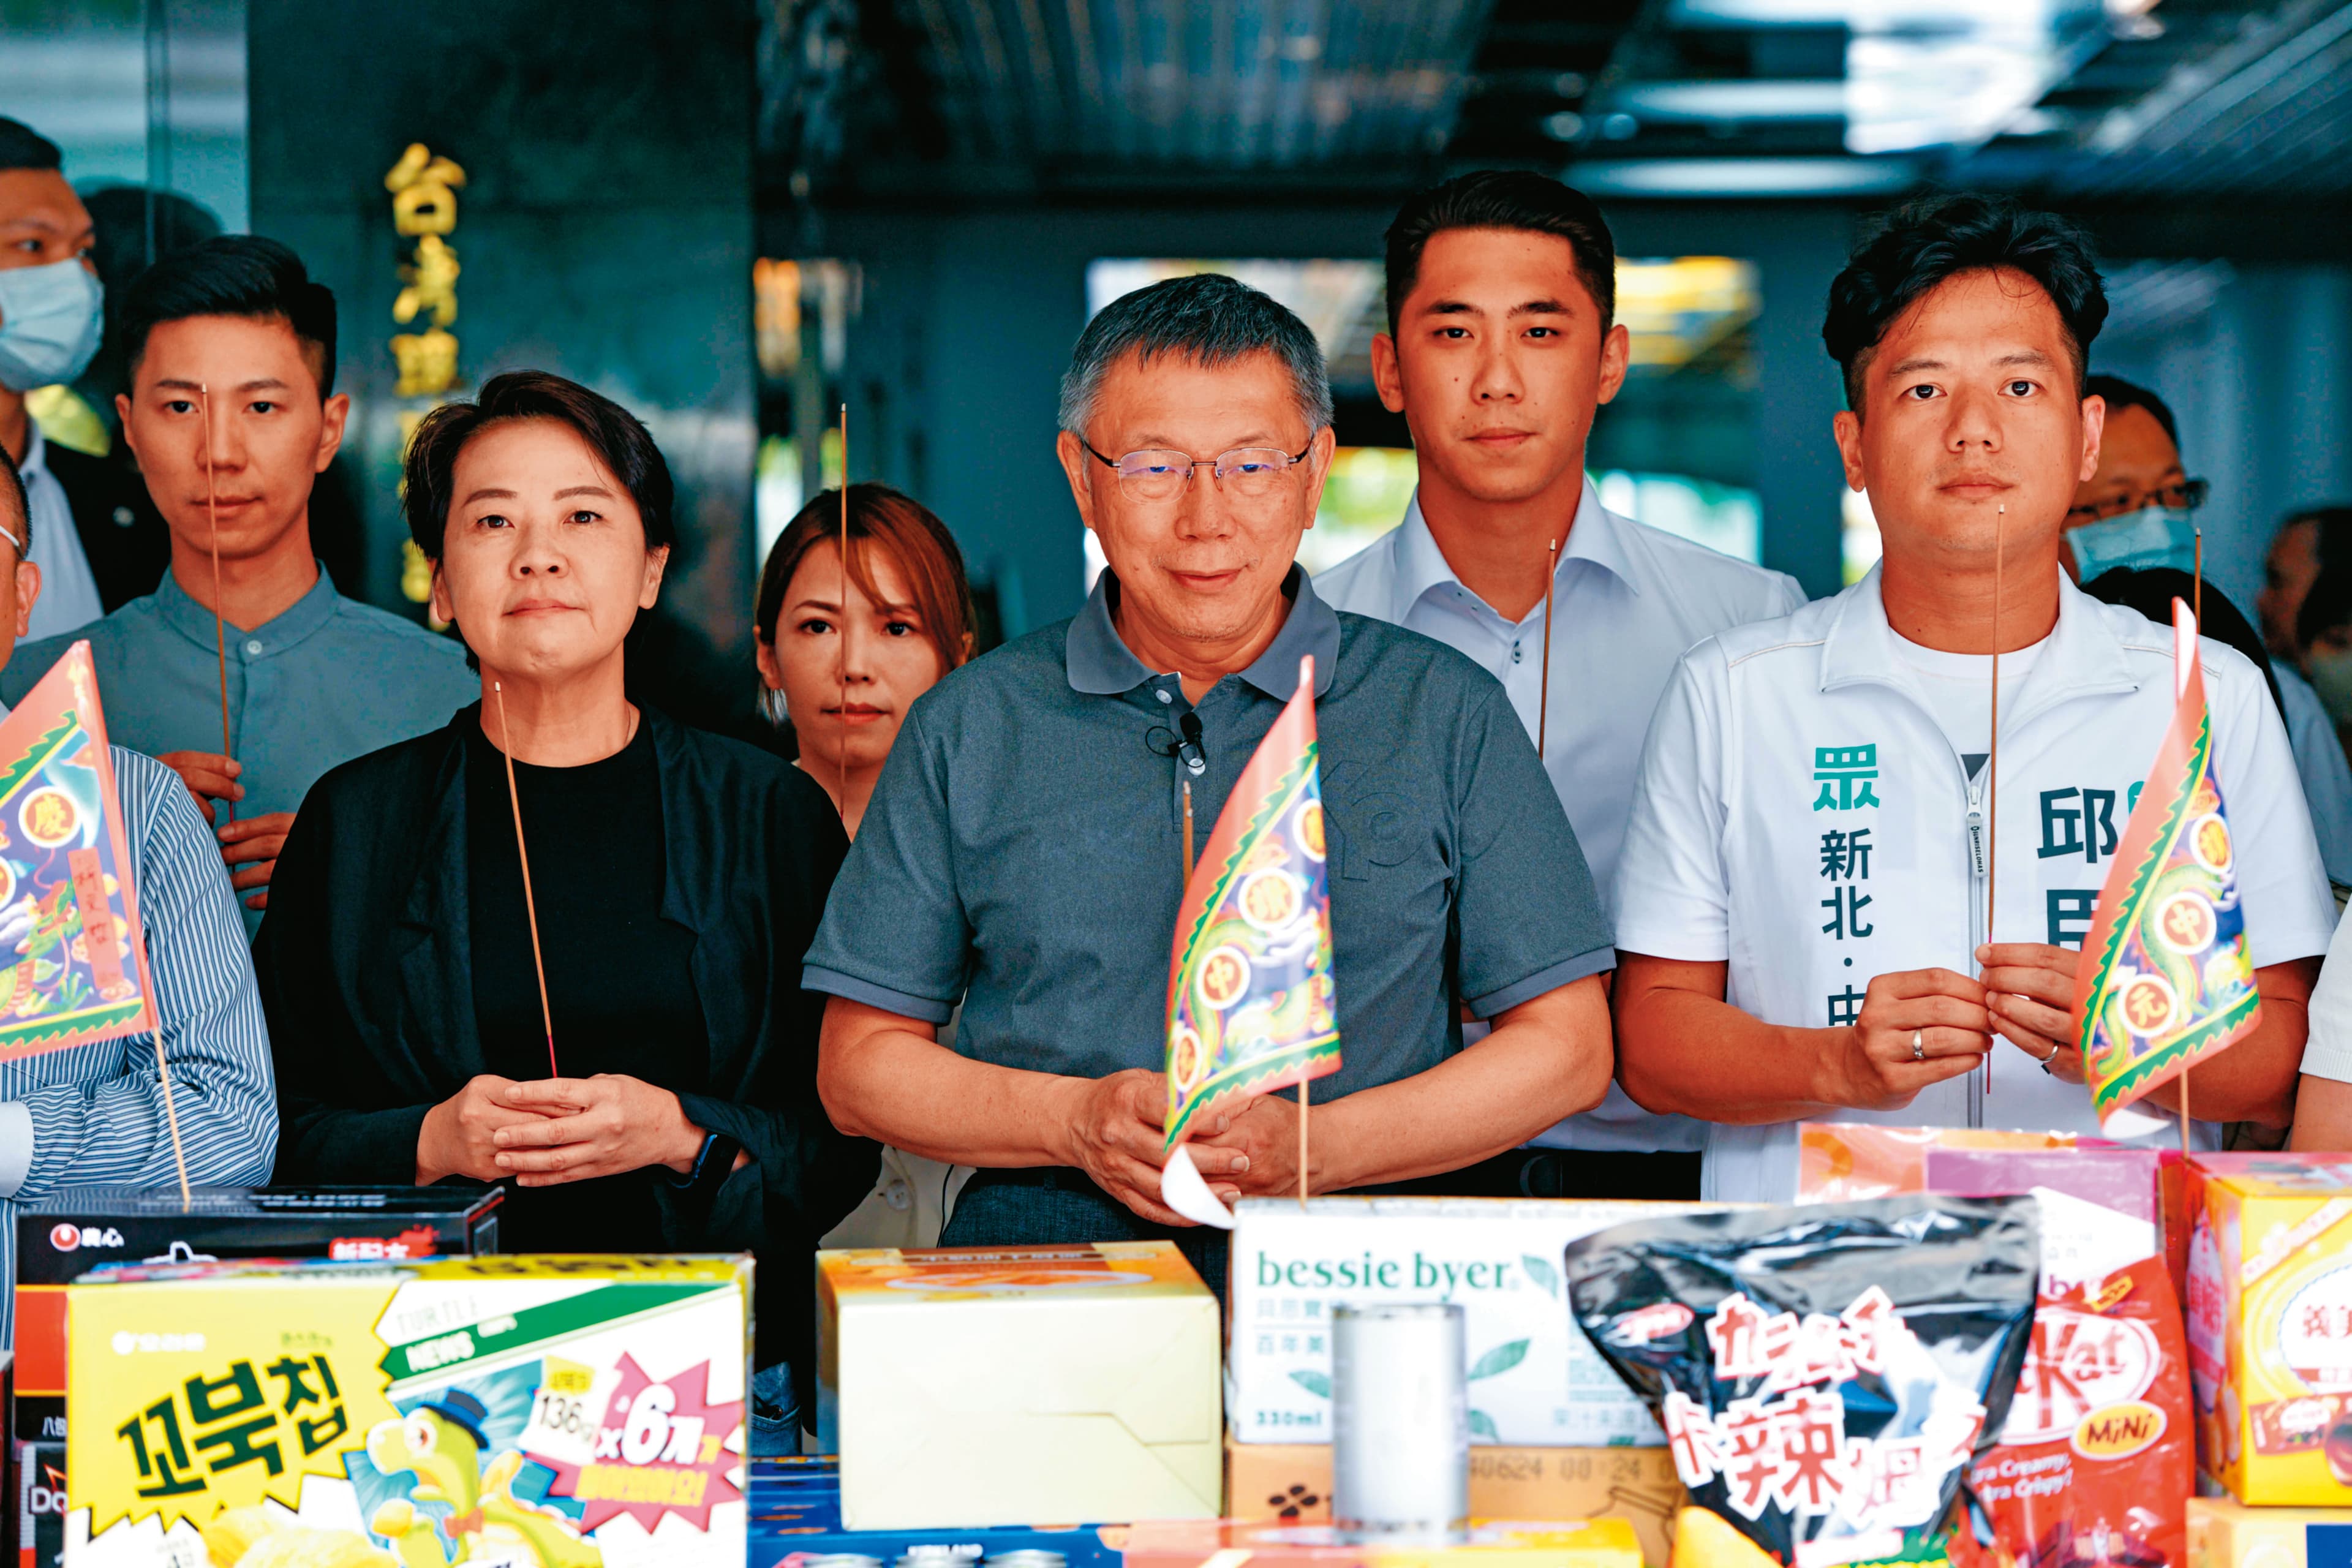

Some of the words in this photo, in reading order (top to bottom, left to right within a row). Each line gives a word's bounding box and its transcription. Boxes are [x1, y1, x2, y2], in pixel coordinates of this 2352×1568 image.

[1813, 744, 1880, 812] 眾
[1257, 1251, 1400, 1287] bessie
[1414, 1251, 1511, 1303] byer
[116, 1355, 349, 1498] 꼬북칩
